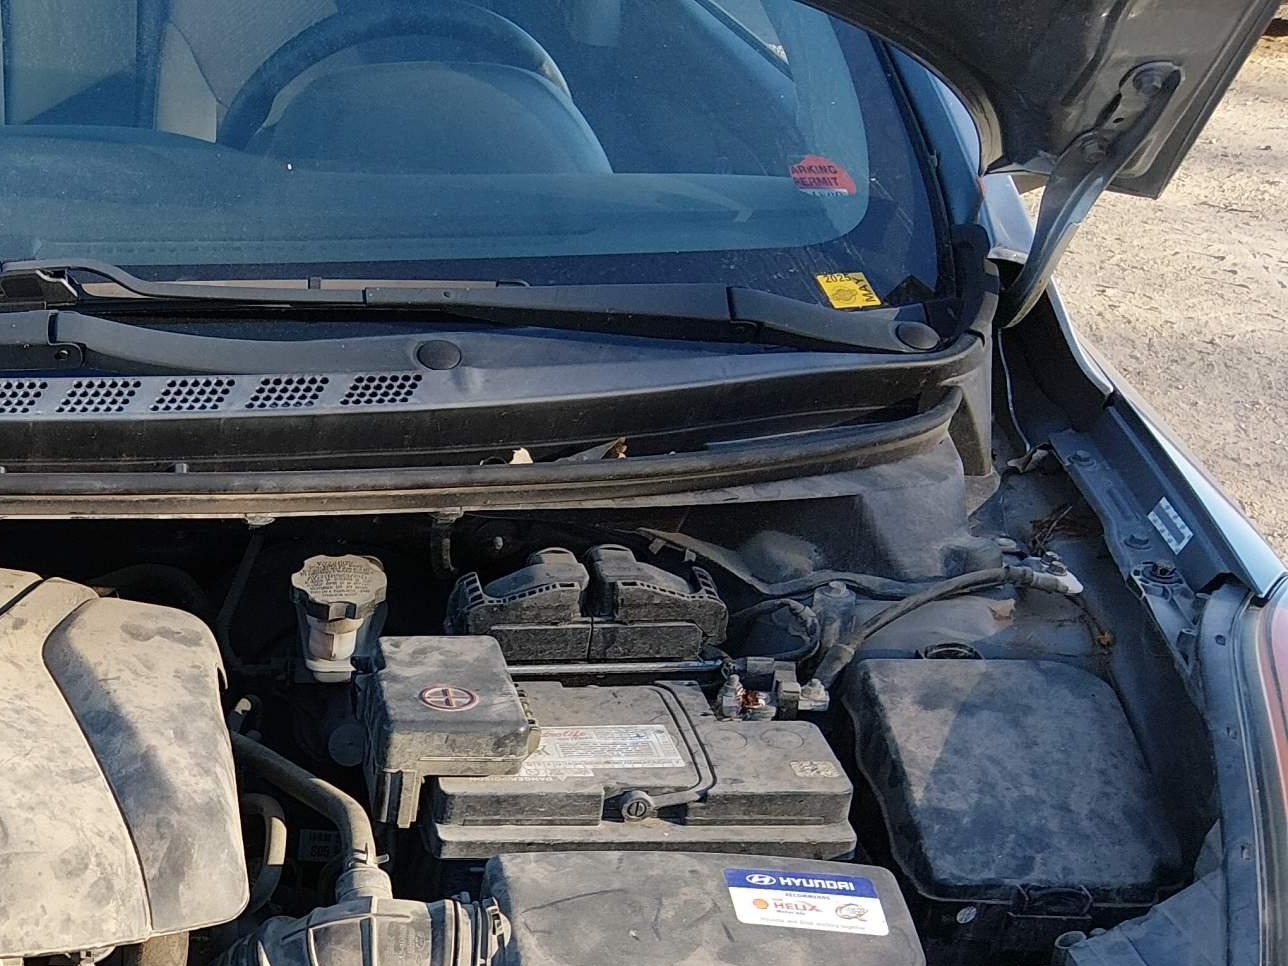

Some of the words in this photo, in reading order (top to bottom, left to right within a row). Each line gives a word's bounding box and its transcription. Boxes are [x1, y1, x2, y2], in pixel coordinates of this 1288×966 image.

[791, 164, 838, 175] ARKING
[792, 176, 839, 187] PERMIT
[823, 273, 852, 283] 2025
[851, 277, 877, 303] MAY
[779, 877, 856, 891] HYUNDAI
[773, 902, 823, 912] HELIX
